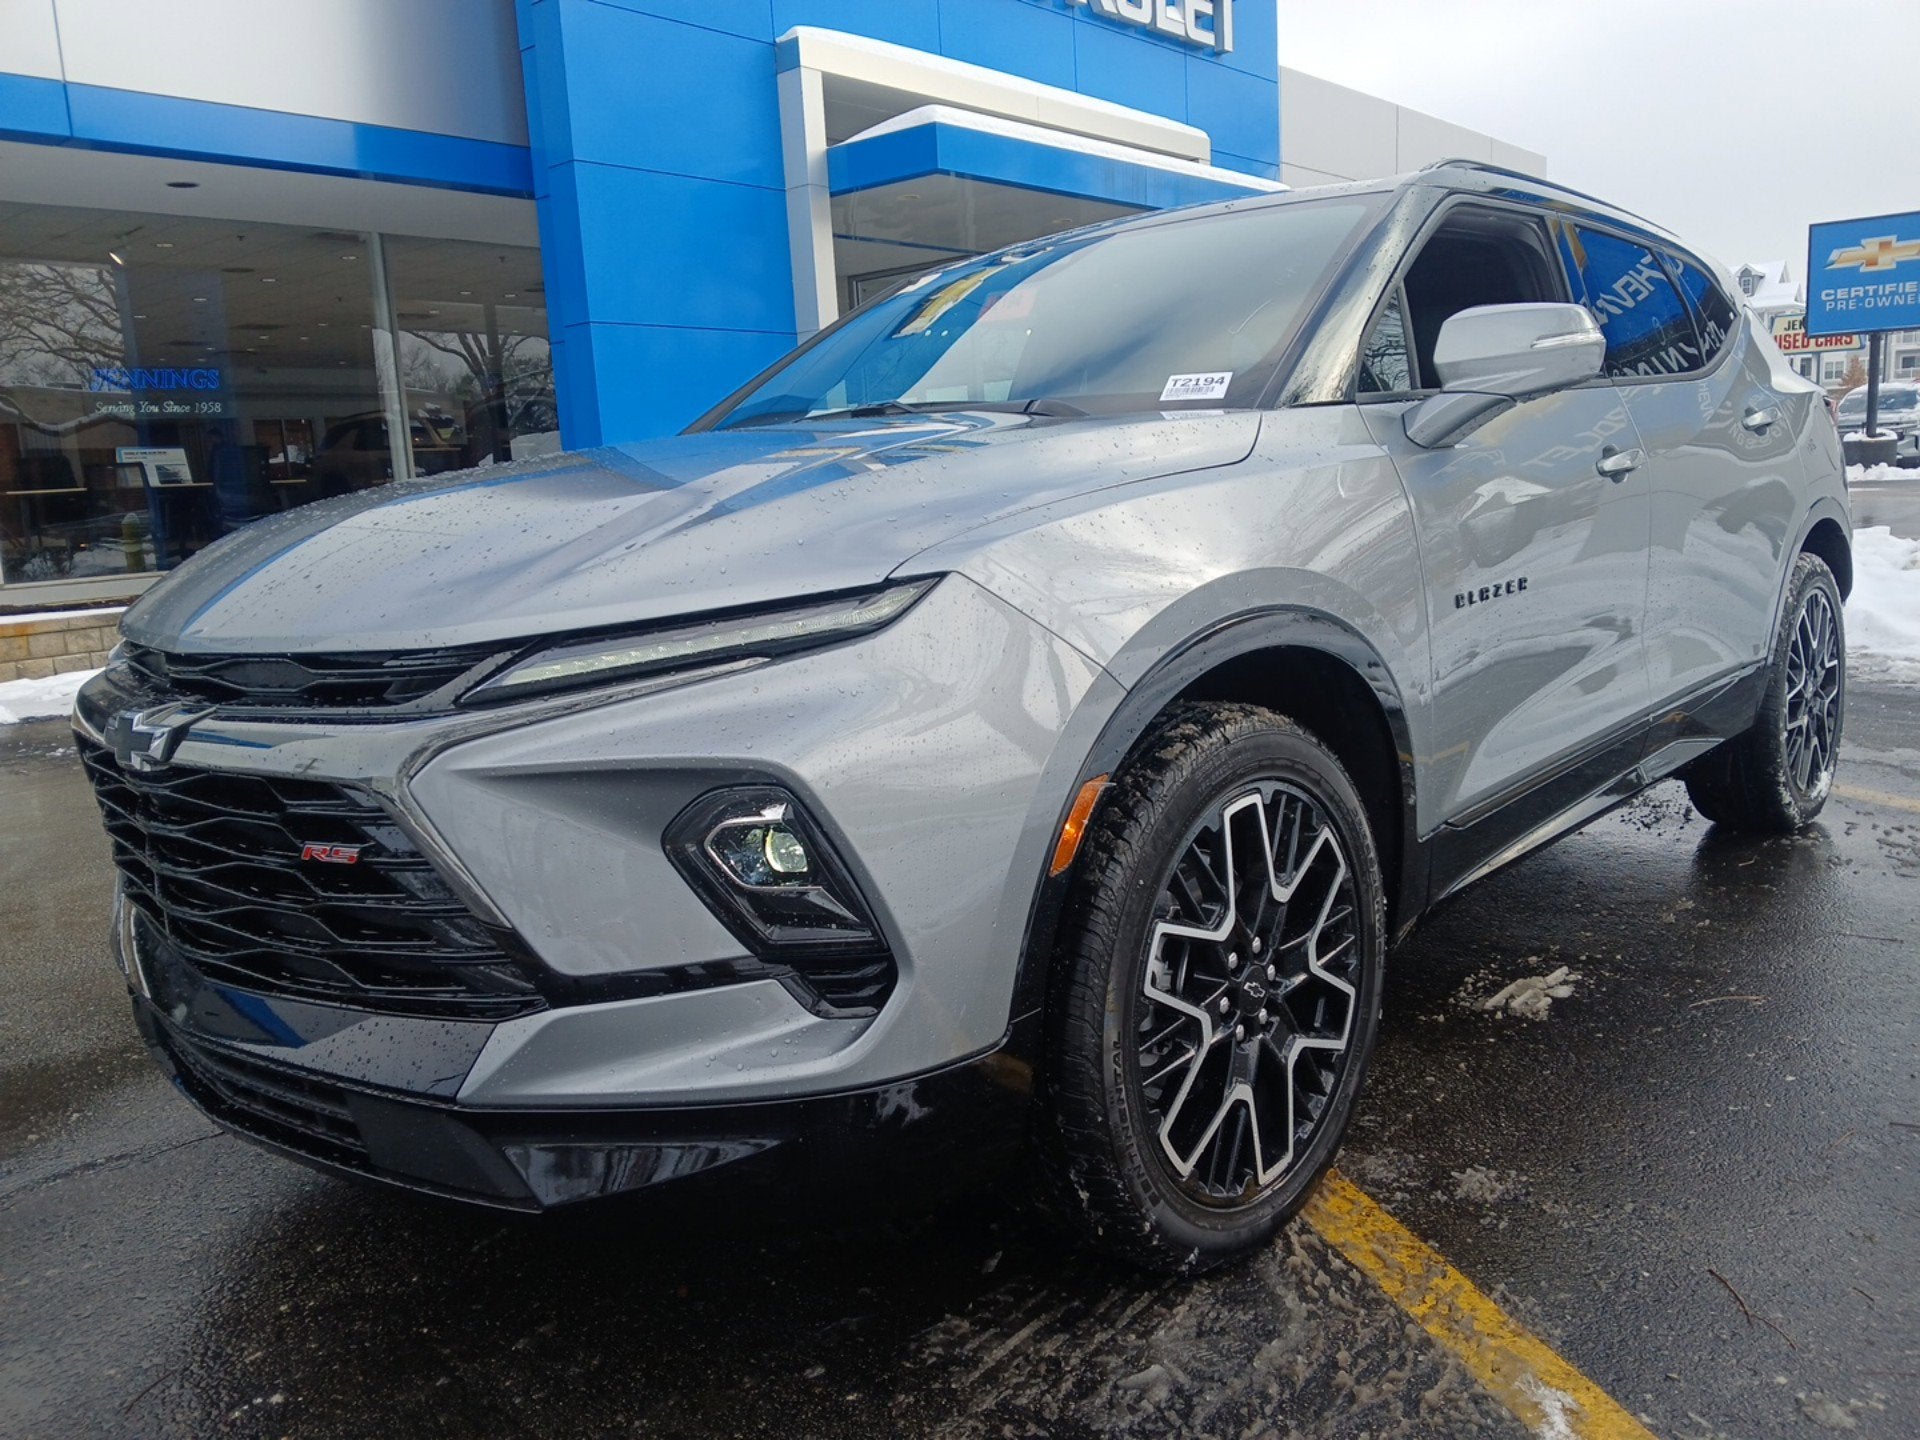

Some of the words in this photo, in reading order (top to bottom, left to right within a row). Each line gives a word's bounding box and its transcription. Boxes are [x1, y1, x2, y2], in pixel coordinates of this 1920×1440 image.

[1821, 281, 1920, 301] CERTIFIE
[1826, 293, 1920, 312] PRE-OWNE
[90, 367, 220, 392] JENNINGS
[1171, 376, 1225, 388] T2194
[95, 401, 135, 418] Serving
[139, 401, 159, 413] You
[163, 401, 191, 413] Since
[194, 402, 222, 413] 1958
[1455, 576, 1528, 609] BLAZER
[301, 844, 360, 864] RS
